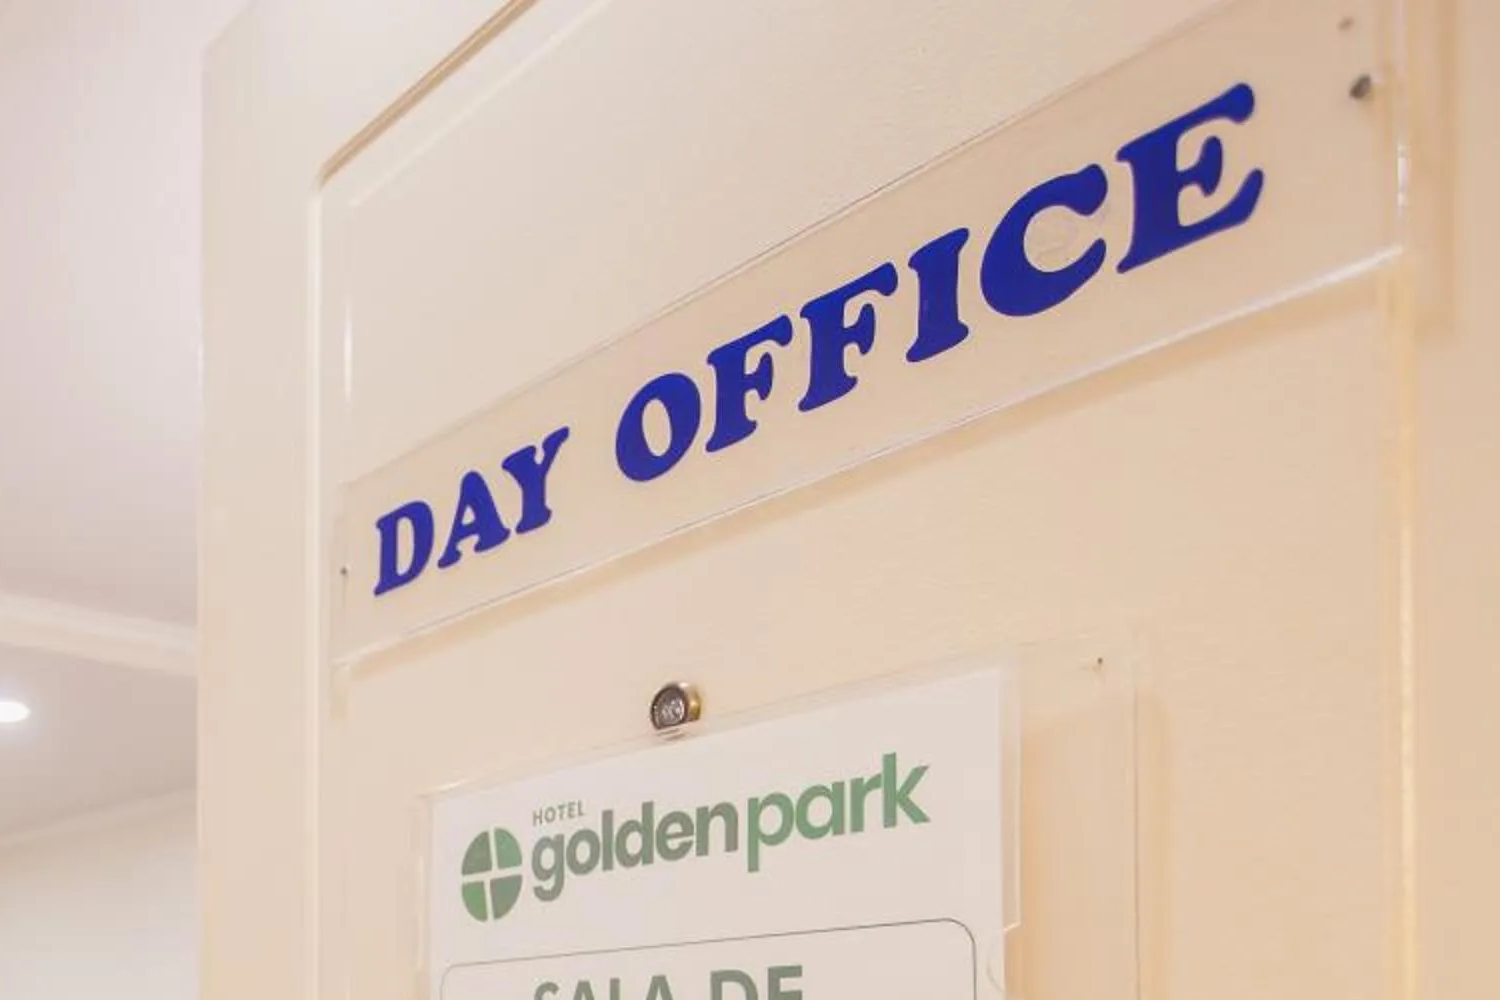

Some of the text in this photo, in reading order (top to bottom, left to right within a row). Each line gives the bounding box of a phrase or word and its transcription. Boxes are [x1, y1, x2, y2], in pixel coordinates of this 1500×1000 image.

[374, 82, 1264, 595] DAY OFFICE
[532, 800, 586, 827] HOTEL
